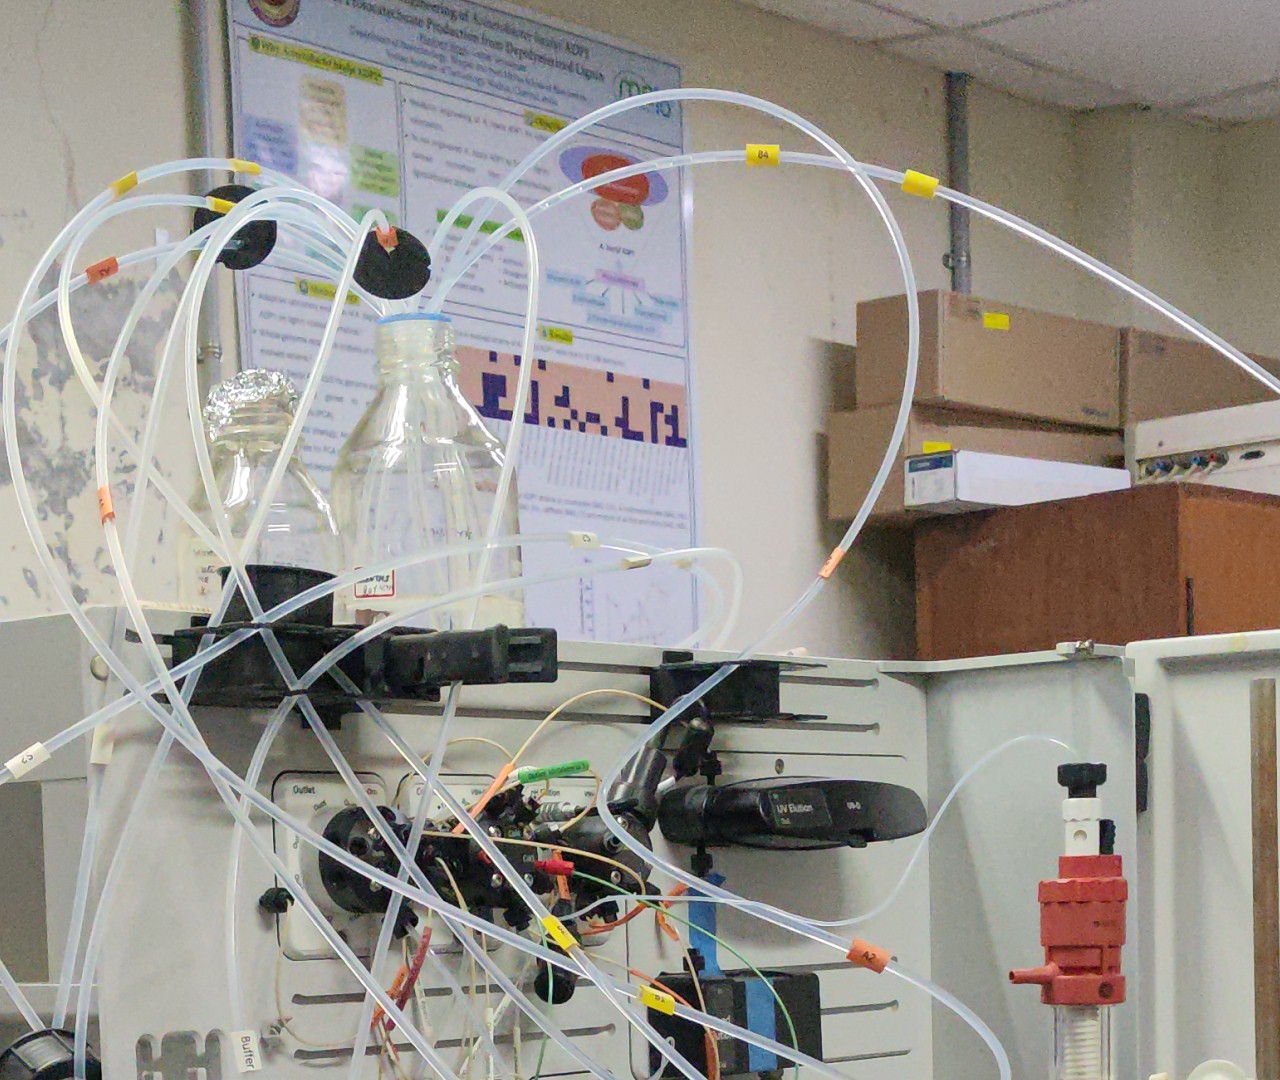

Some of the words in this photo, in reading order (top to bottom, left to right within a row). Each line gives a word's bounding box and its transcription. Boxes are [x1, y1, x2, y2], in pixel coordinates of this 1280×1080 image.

[292, 784, 317, 796] Outlet
[776, 804, 787, 814] UV
[788, 803, 813, 814] Elution
